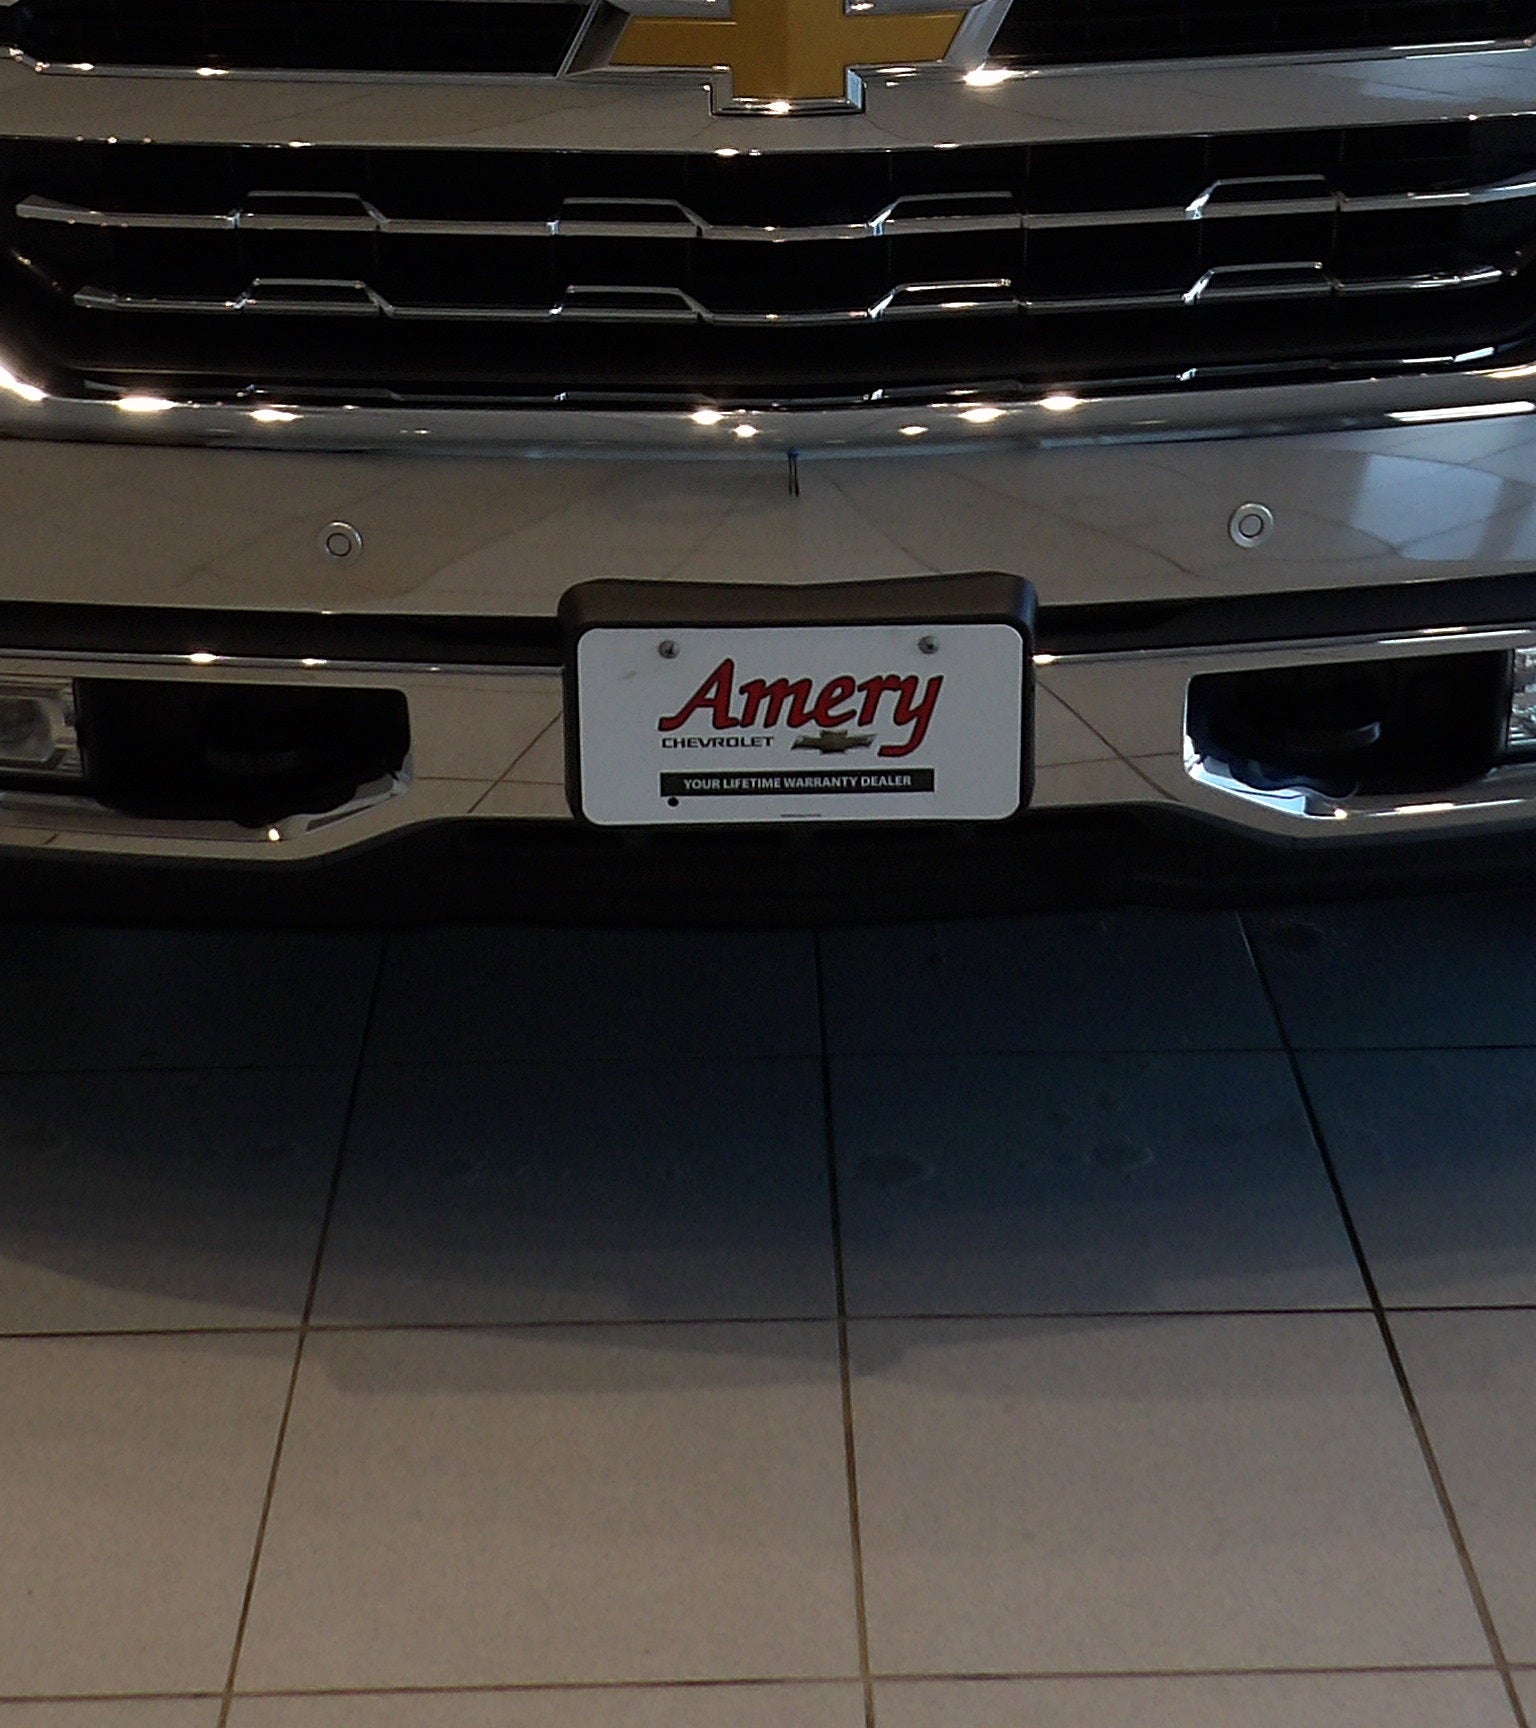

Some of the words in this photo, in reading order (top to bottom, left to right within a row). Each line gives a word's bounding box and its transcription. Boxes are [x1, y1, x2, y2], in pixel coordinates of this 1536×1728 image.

[657, 657, 945, 757] Amery
[661, 735, 775, 749] CHEVROLET
[683, 778, 721, 790] YOUR
[722, 777, 782, 790] LIFETIME
[783, 775, 857, 789] WARRANTY
[860, 774, 912, 788] DEALER
